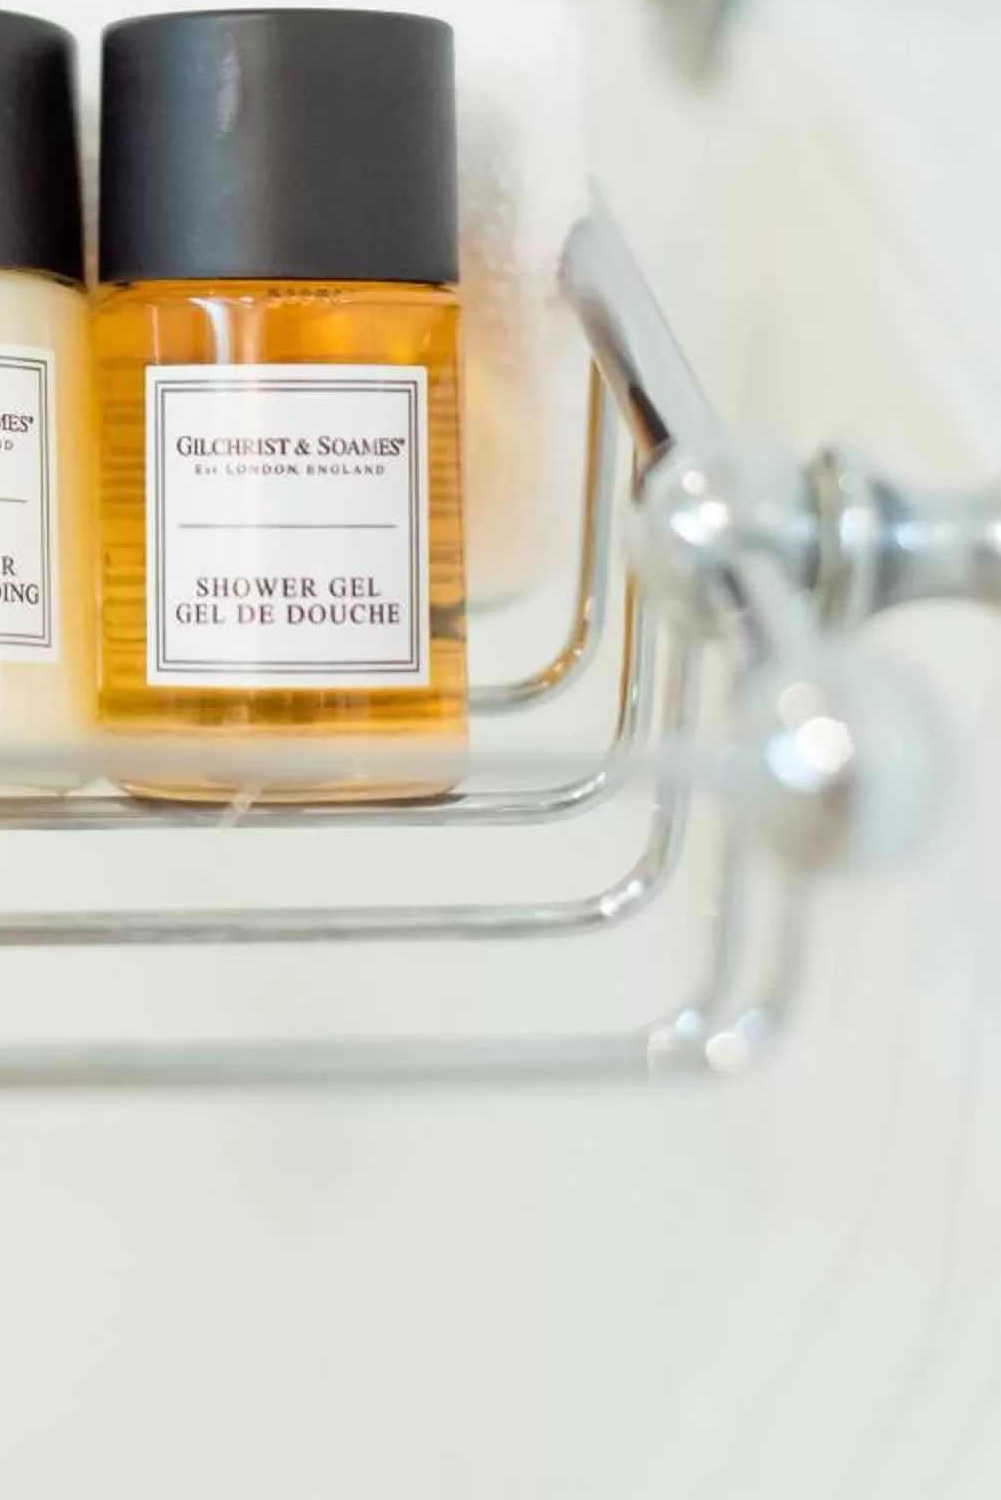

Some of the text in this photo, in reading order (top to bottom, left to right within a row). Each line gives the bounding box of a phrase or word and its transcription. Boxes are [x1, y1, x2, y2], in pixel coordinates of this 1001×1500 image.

[176, 435, 292, 457] GILCHRIST
[294, 437, 311, 457] &
[306, 463, 386, 476] ENGLAND
[196, 576, 382, 599] SHOWER GEL
[175, 602, 402, 626] GEL DE DOUCHE
